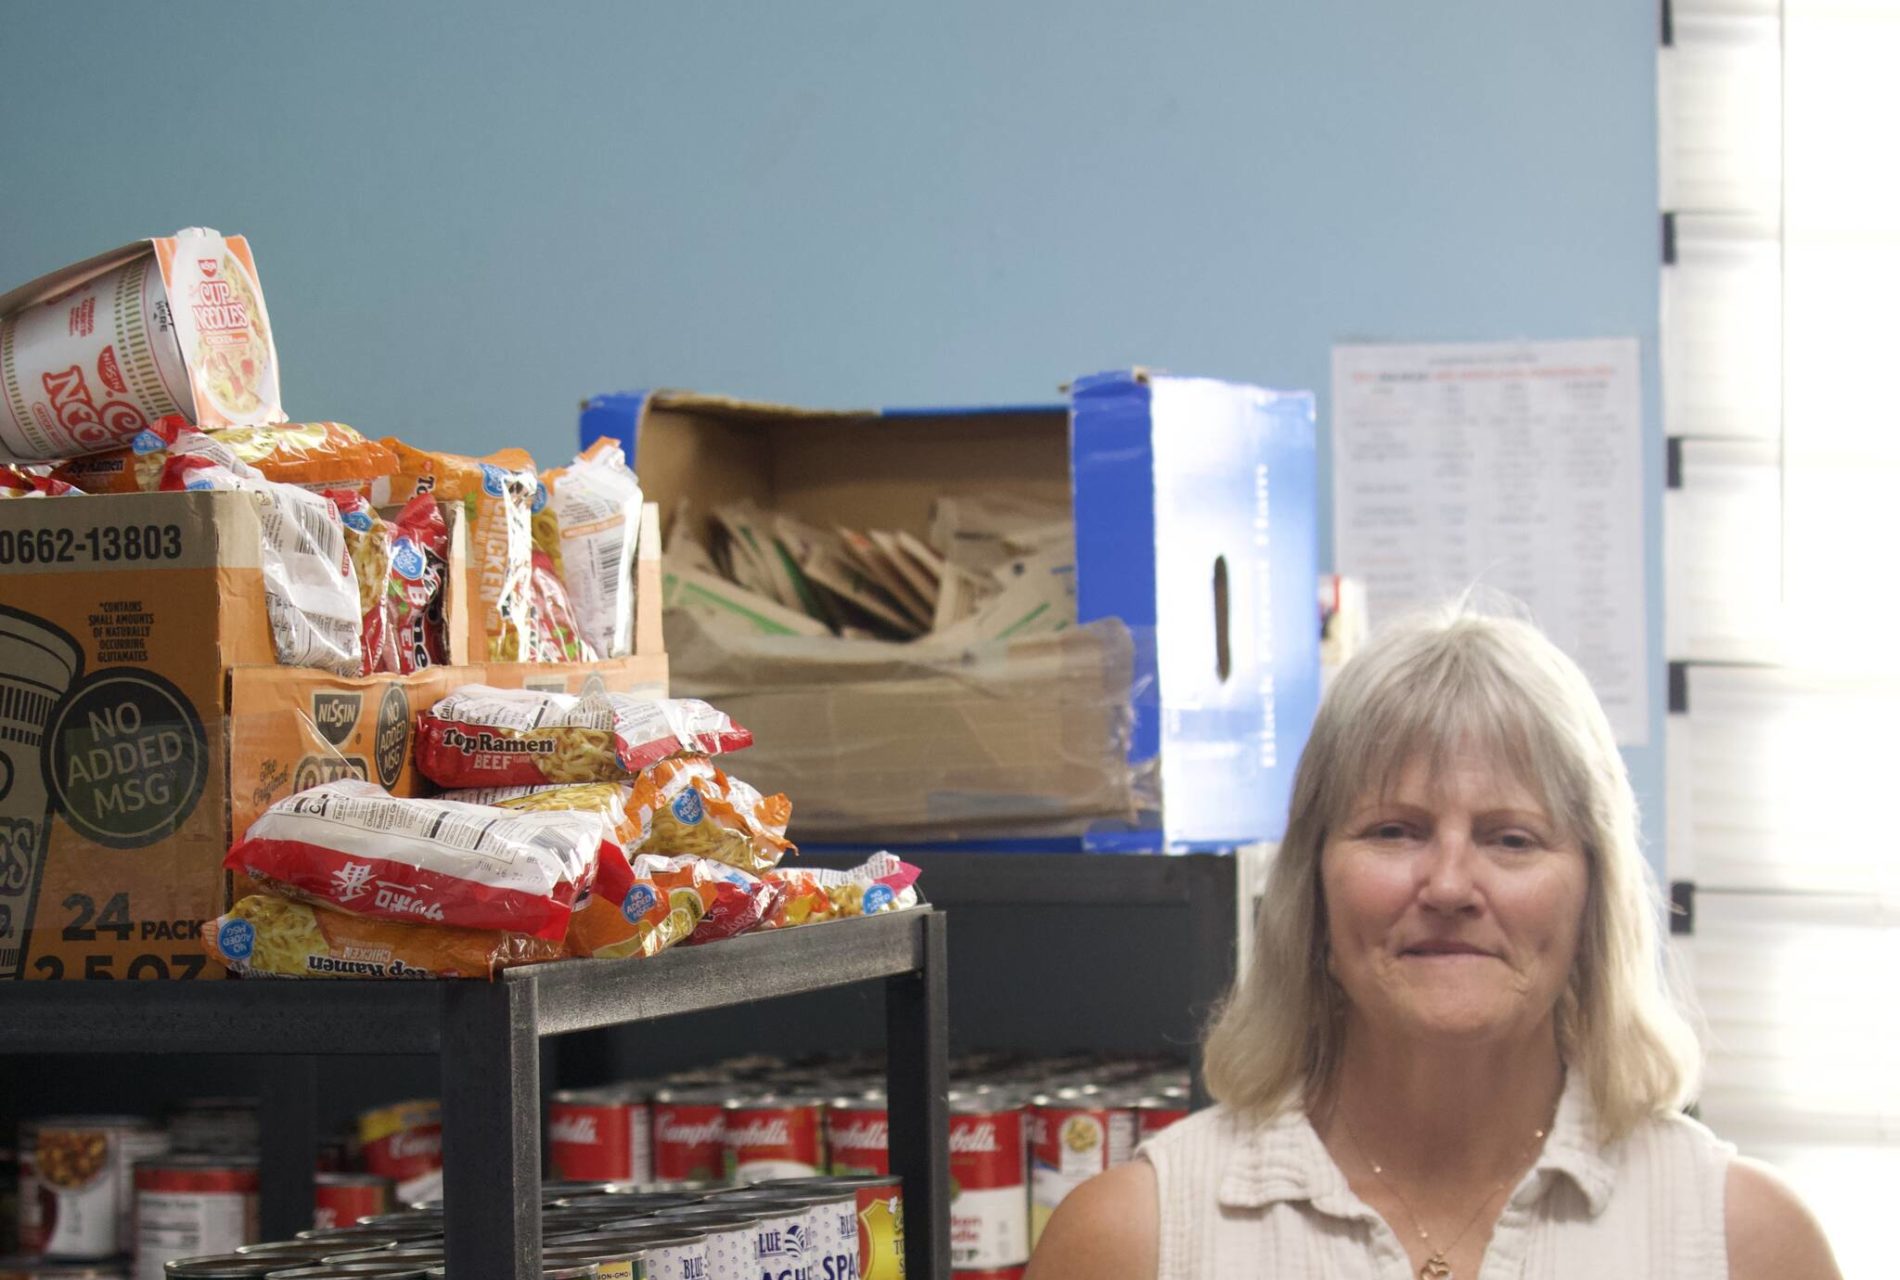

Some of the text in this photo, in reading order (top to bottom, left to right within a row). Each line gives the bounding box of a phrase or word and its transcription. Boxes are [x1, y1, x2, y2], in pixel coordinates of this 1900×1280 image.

[200, 281, 231, 306] CUP
[155, 301, 168, 332] HERE
[192, 303, 249, 331] NOODLES
[102, 351, 123, 390] NISSIN
[480, 502, 507, 603] CHICKEN
[89, 613, 154, 626] SMALL AMOUNTS
[93, 627, 150, 638] OF NATURALLY
[101, 639, 144, 649] OCCURRING
[98, 651, 147, 662] GLUTAMATES
[88, 702, 141, 742] NO
[318, 700, 356, 727] NISSIN
[387, 703, 399, 723] NO
[380, 721, 406, 753] ADDED
[443, 728, 554, 754] Top Ramen
[68, 731, 183, 787] ADDED
[384, 748, 400, 772] MSG
[474, 754, 512, 770] BEEF
[94, 773, 170, 819] MSG
[680, 791, 693, 802] NO
[374, 889, 445, 921] サッポロ
[626, 895, 649, 914] ADDED
[631, 890, 643, 901] NO
[62, 893, 203, 941] 24 PACK
[223, 934, 250, 946] ADDED
[232, 944, 246, 953] NO
[309, 955, 385, 976] Ramen
[344, 947, 391, 961] CHICKEN
[754, 1231, 781, 1257] LUE
